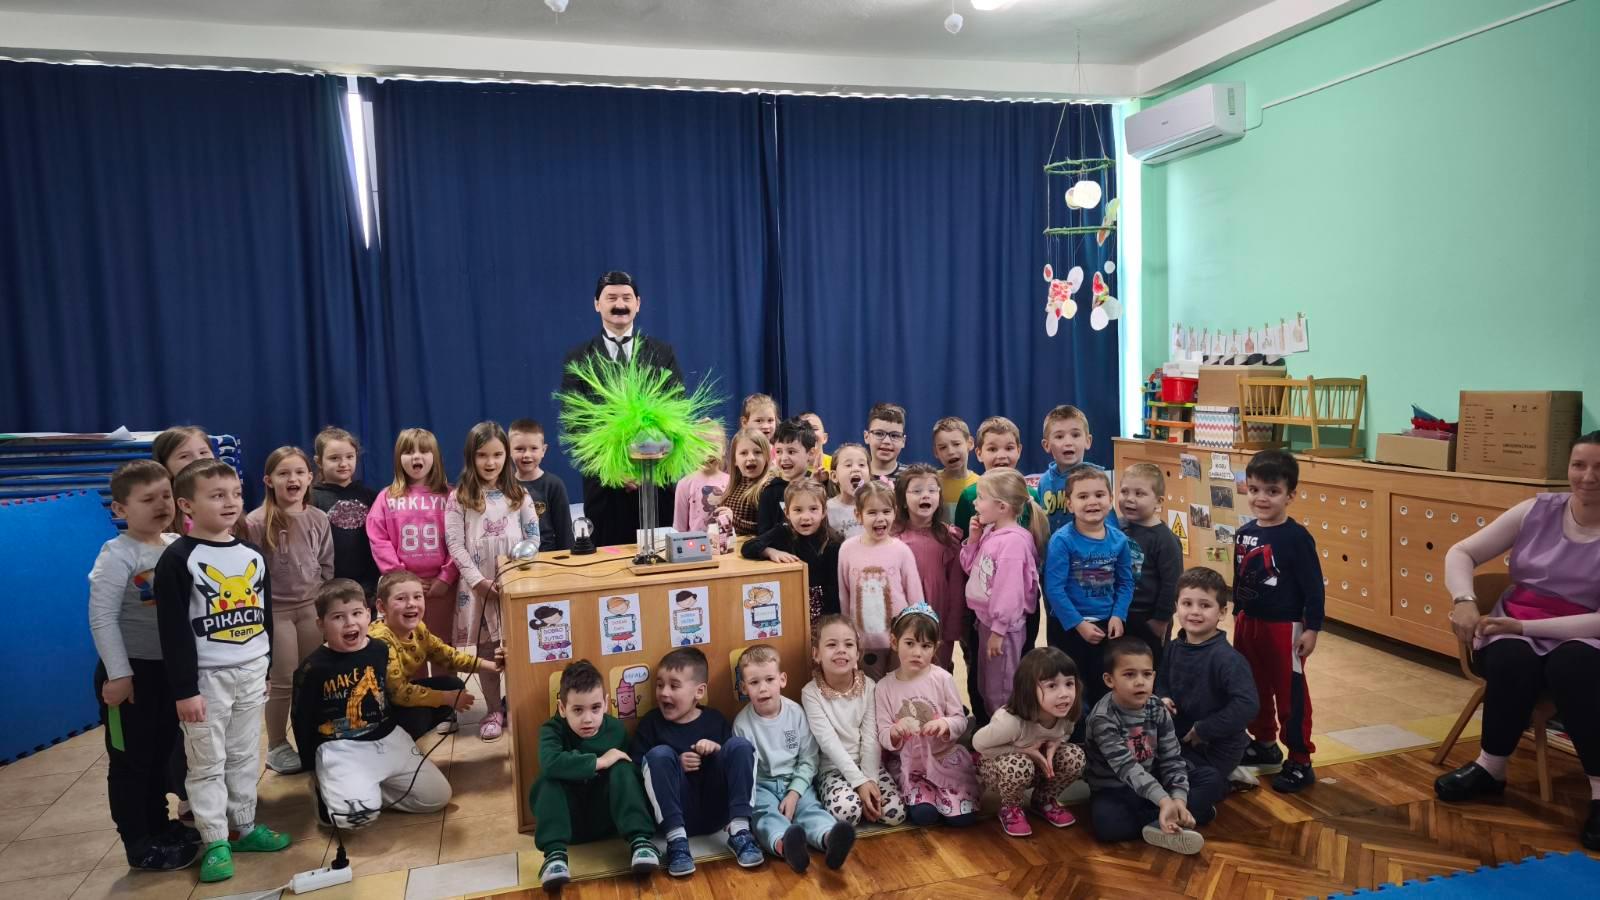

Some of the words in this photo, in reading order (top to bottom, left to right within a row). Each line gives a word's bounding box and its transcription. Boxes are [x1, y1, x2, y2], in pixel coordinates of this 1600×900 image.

[401, 523, 439, 552] 89
[229, 627, 254, 638] Team
[323, 667, 359, 693] MAKE
